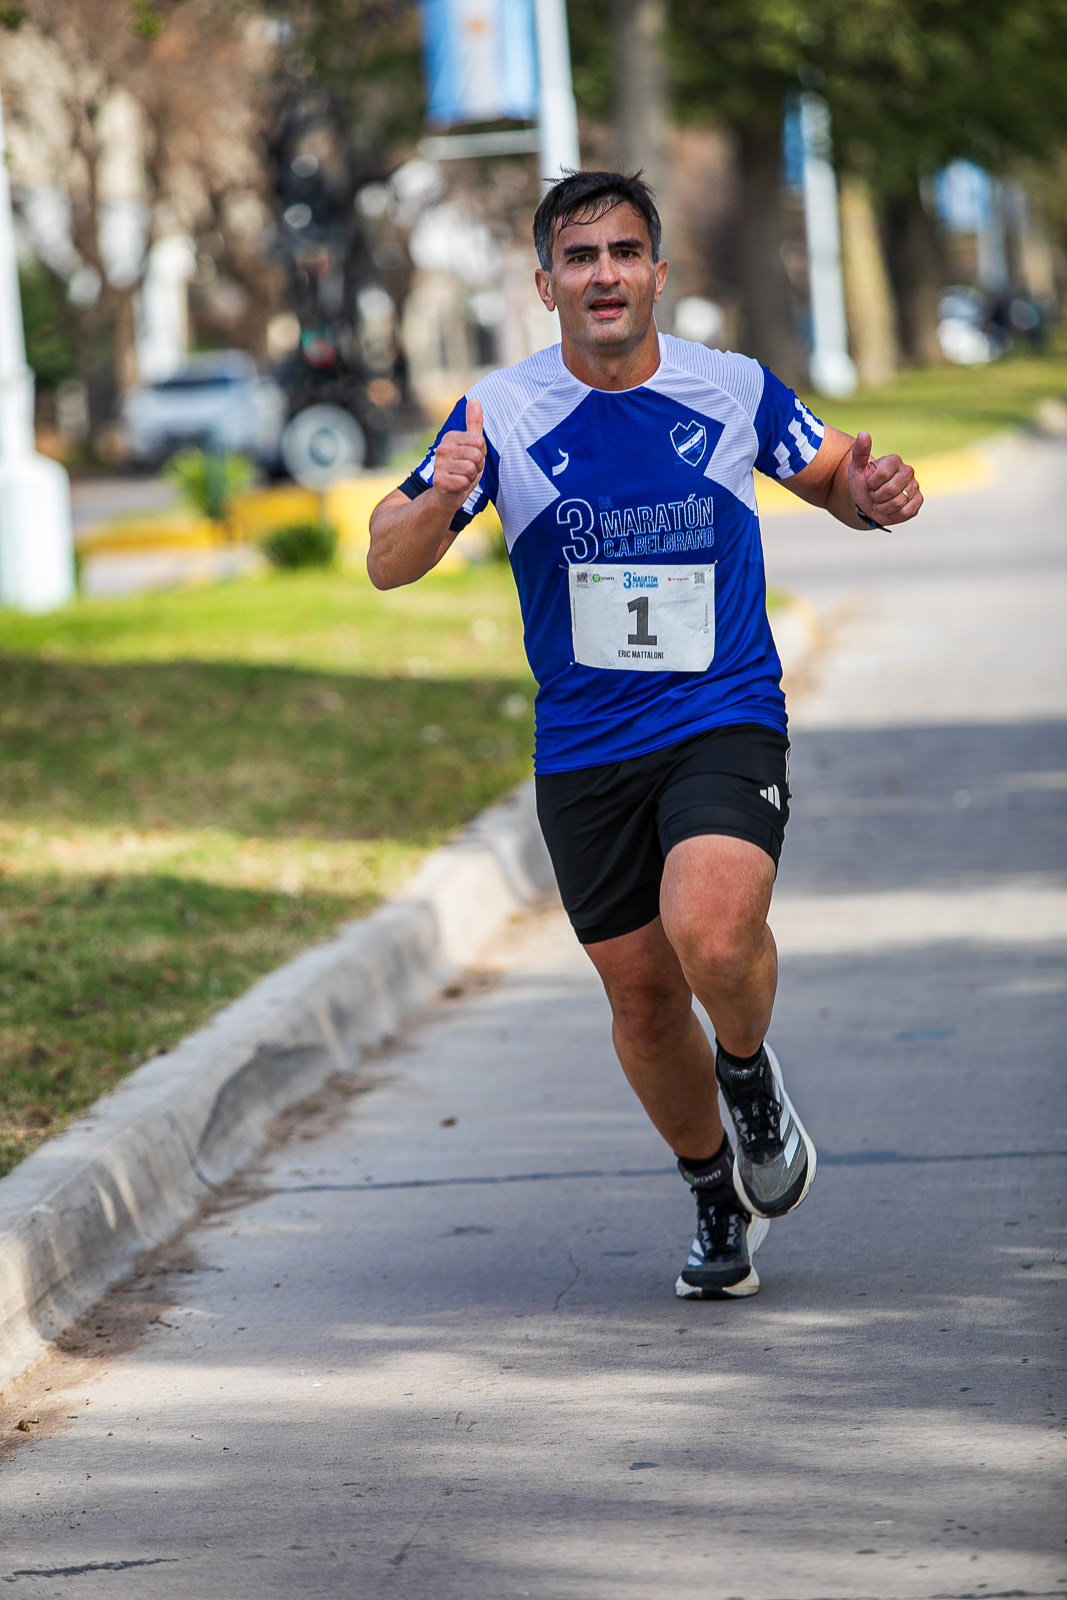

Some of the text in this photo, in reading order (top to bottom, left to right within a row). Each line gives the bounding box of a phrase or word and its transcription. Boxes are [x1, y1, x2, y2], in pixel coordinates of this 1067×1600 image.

[556, 498, 599, 564] 3
[599, 493, 714, 539] MARATÓN
[623, 571, 632, 589] 3
[627, 596, 657, 646] 1
[618, 650, 664, 660] ERIC MATTALONI
